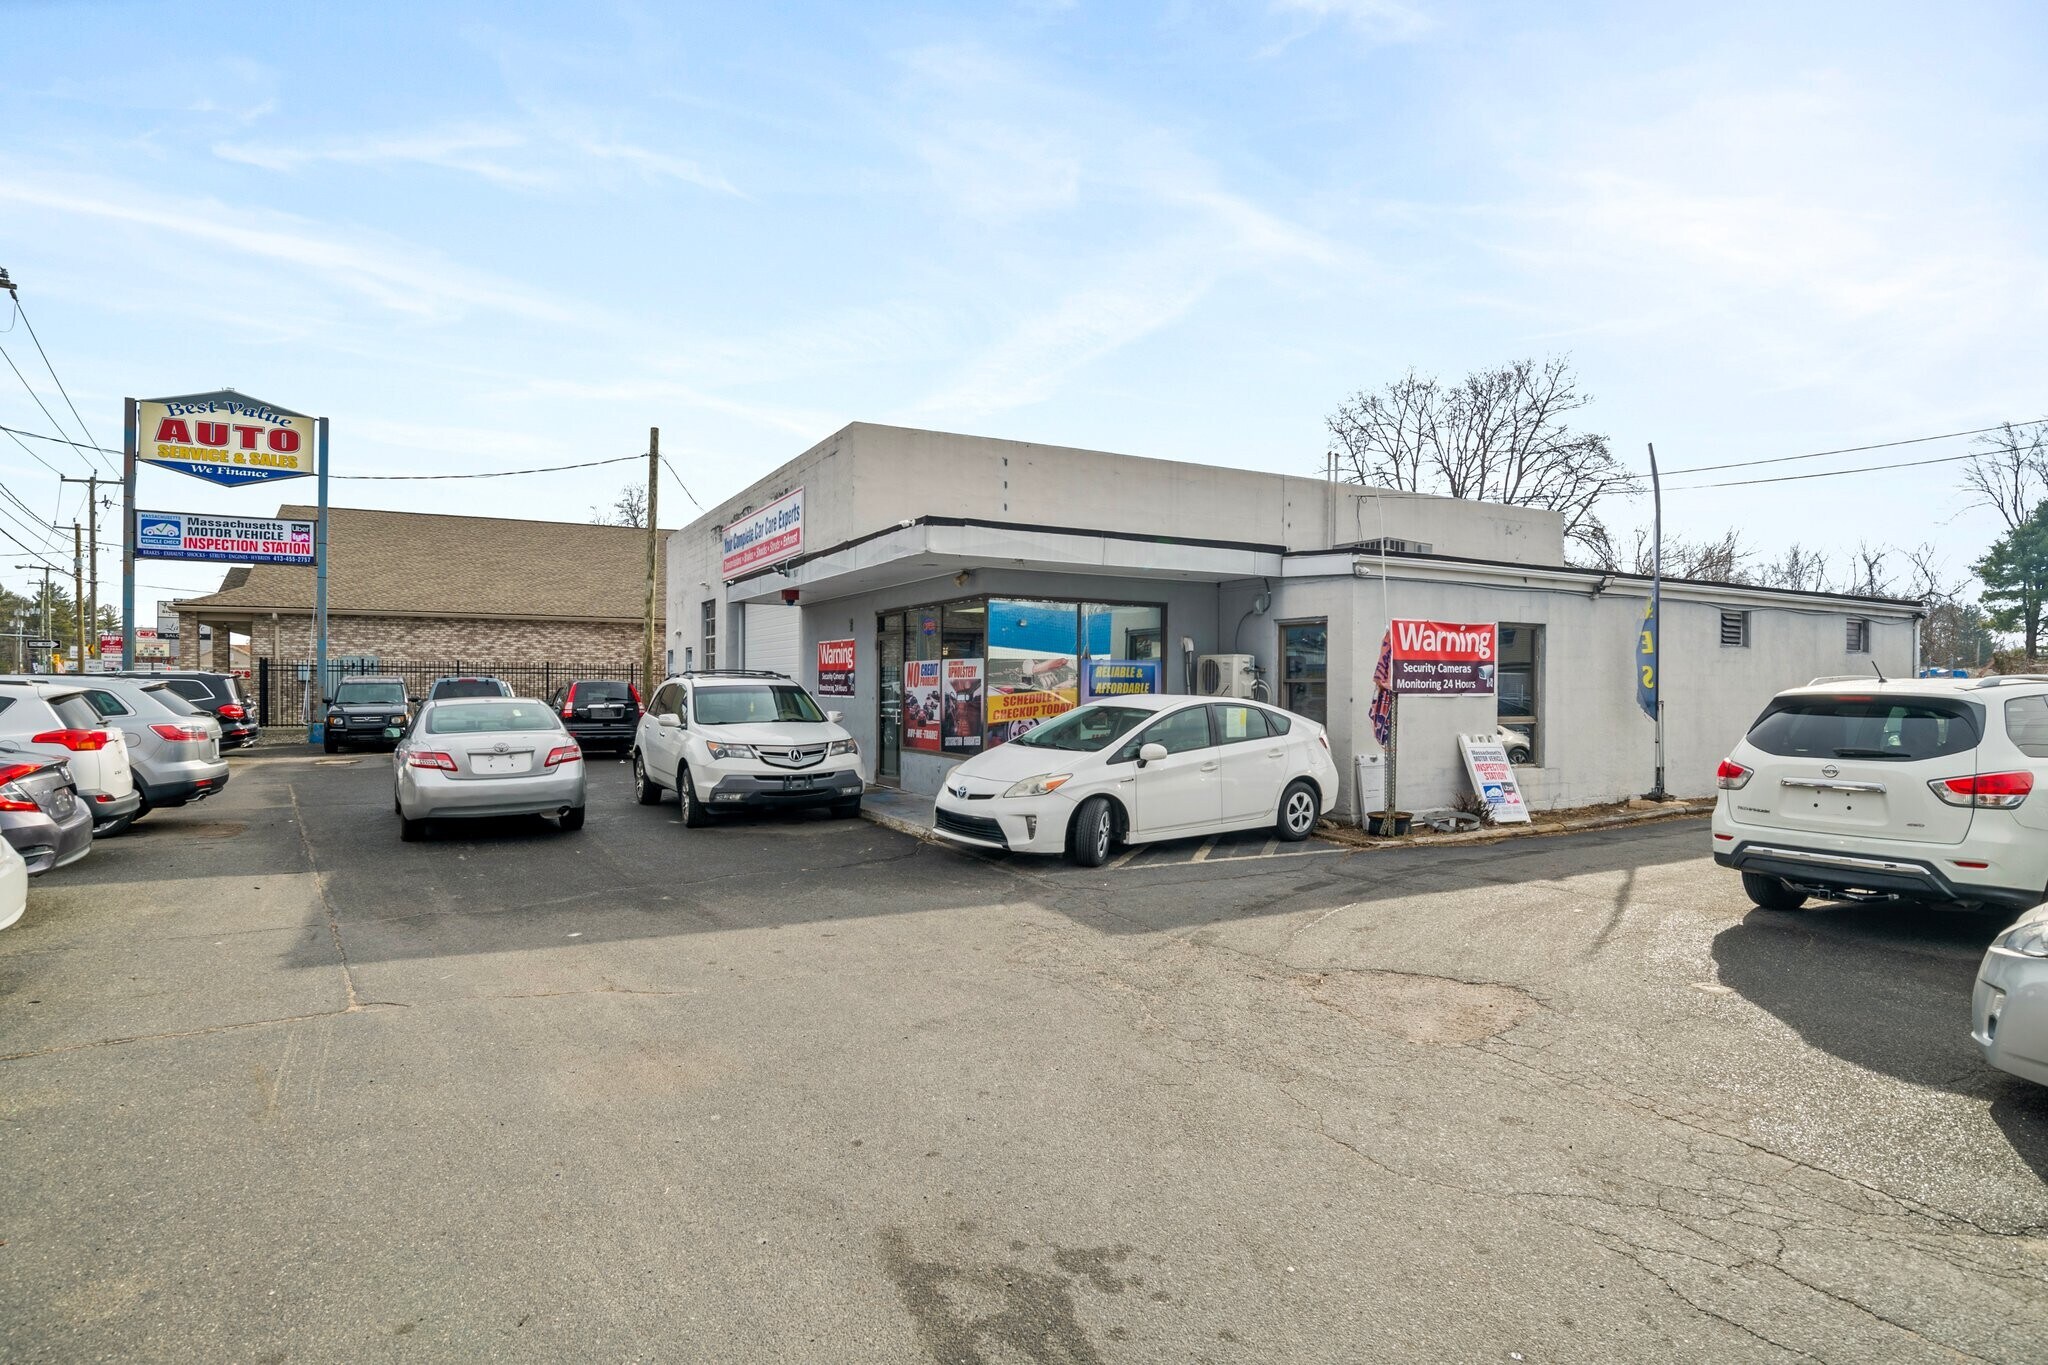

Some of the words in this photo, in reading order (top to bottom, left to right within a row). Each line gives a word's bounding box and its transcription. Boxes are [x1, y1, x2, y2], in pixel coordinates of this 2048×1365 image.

[165, 401, 218, 416] Best
[224, 401, 292, 427] Value
[154, 417, 301, 453] AUTO
[158, 444, 229, 463] SERVICE
[233, 453, 246, 464] &
[249, 453, 298, 468] SALES
[191, 465, 213, 474] We
[216, 467, 269, 478] Finance
[187, 517, 284, 530] Massachusetts
[292, 524, 310, 532] Uber
[755, 522, 764, 539] Car
[765, 517, 777, 535] Care
[779, 503, 800, 531] Experts
[187, 527, 231, 538] MOTOR
[236, 529, 284, 541] VEHICLE
[184, 537, 258, 552] INSPECTION
[262, 541, 310, 554] STATION
[1398, 623, 1491, 659] Warning
[820, 643, 853, 669] Warning
[907, 662, 920, 688] NO
[921, 663, 939, 676] CREDIT
[948, 666, 977, 678] UPHOLSTERY
[1095, 665, 1136, 678] RELIABLE
[1136, 667, 1143, 678] &
[1403, 663, 1436, 675] Security
[1437, 663, 1472, 673] Cameras
[1095, 682, 1150, 694] AFFORDABLE
[1396, 678, 1442, 690] Monitoring
[1443, 679, 1453, 688] 24
[1455, 680, 1476, 689] Hours
[1003, 692, 1052, 707] SCHEDULE
[993, 706, 1040, 720] CHECKUP
[1474, 763, 1508, 772] INSPECTION
[1483, 772, 1508, 780] STATION
